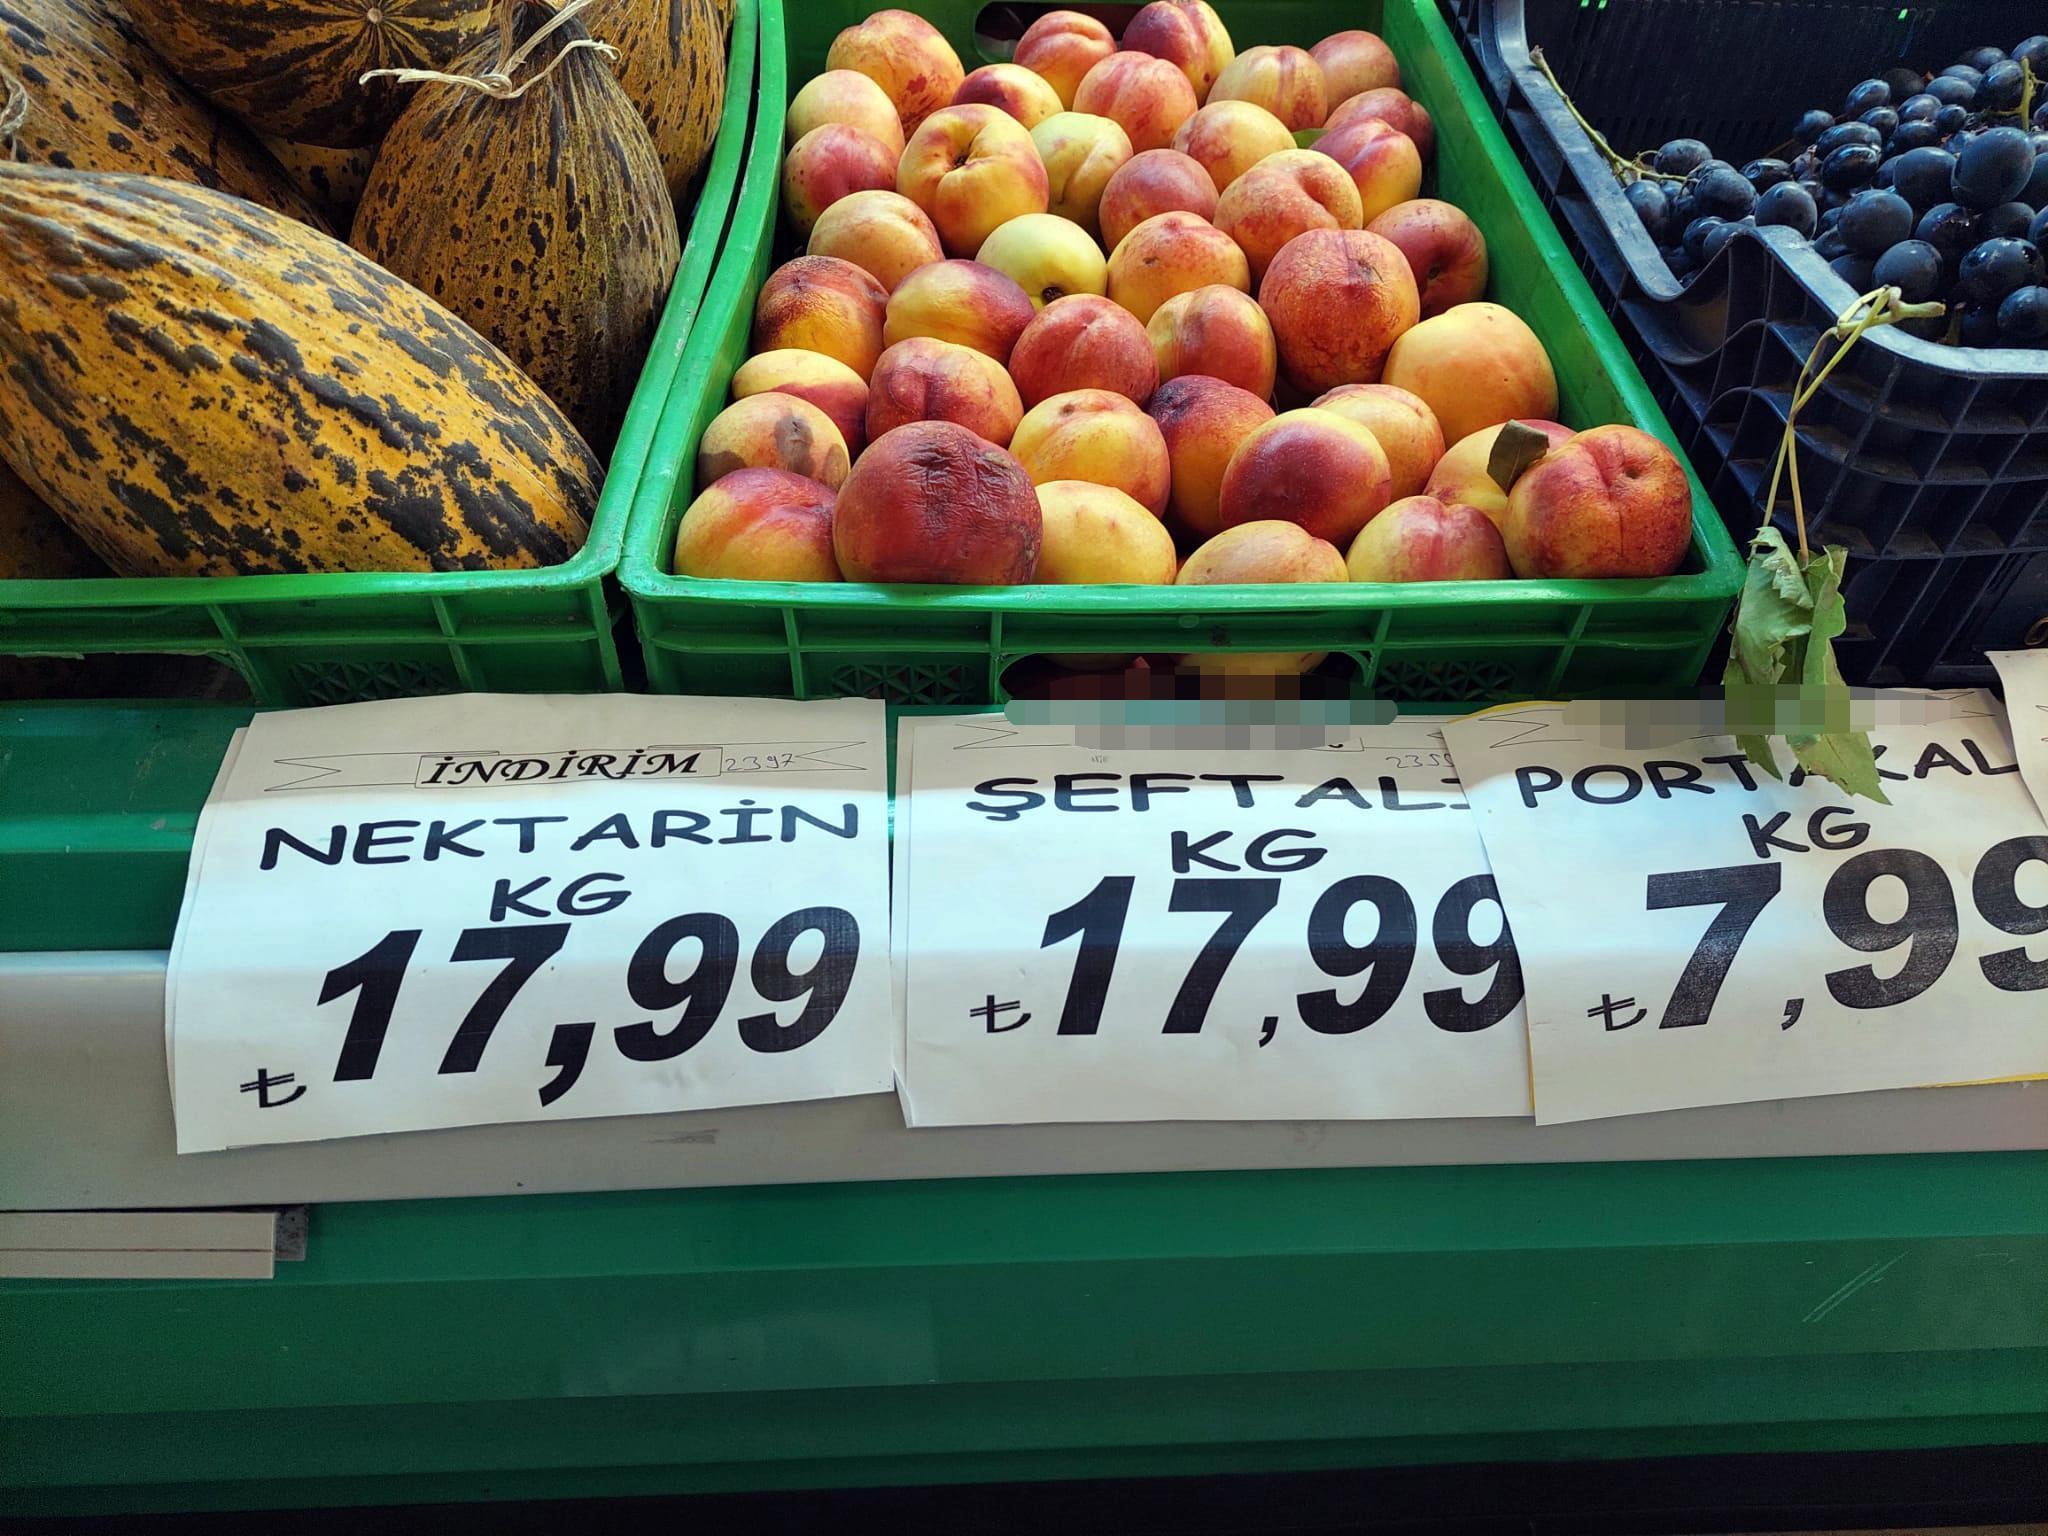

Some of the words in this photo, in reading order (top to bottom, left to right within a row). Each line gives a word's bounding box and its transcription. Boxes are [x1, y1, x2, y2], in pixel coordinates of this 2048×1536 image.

[421, 749, 702, 785] İNDİRİM
[1514, 738, 2020, 809] PORTAL
[259, 799, 859, 871] NEKTARİN
[1170, 828, 1329, 874] KG
[1741, 805, 1871, 859] KG
[489, 872, 632, 923] KG
